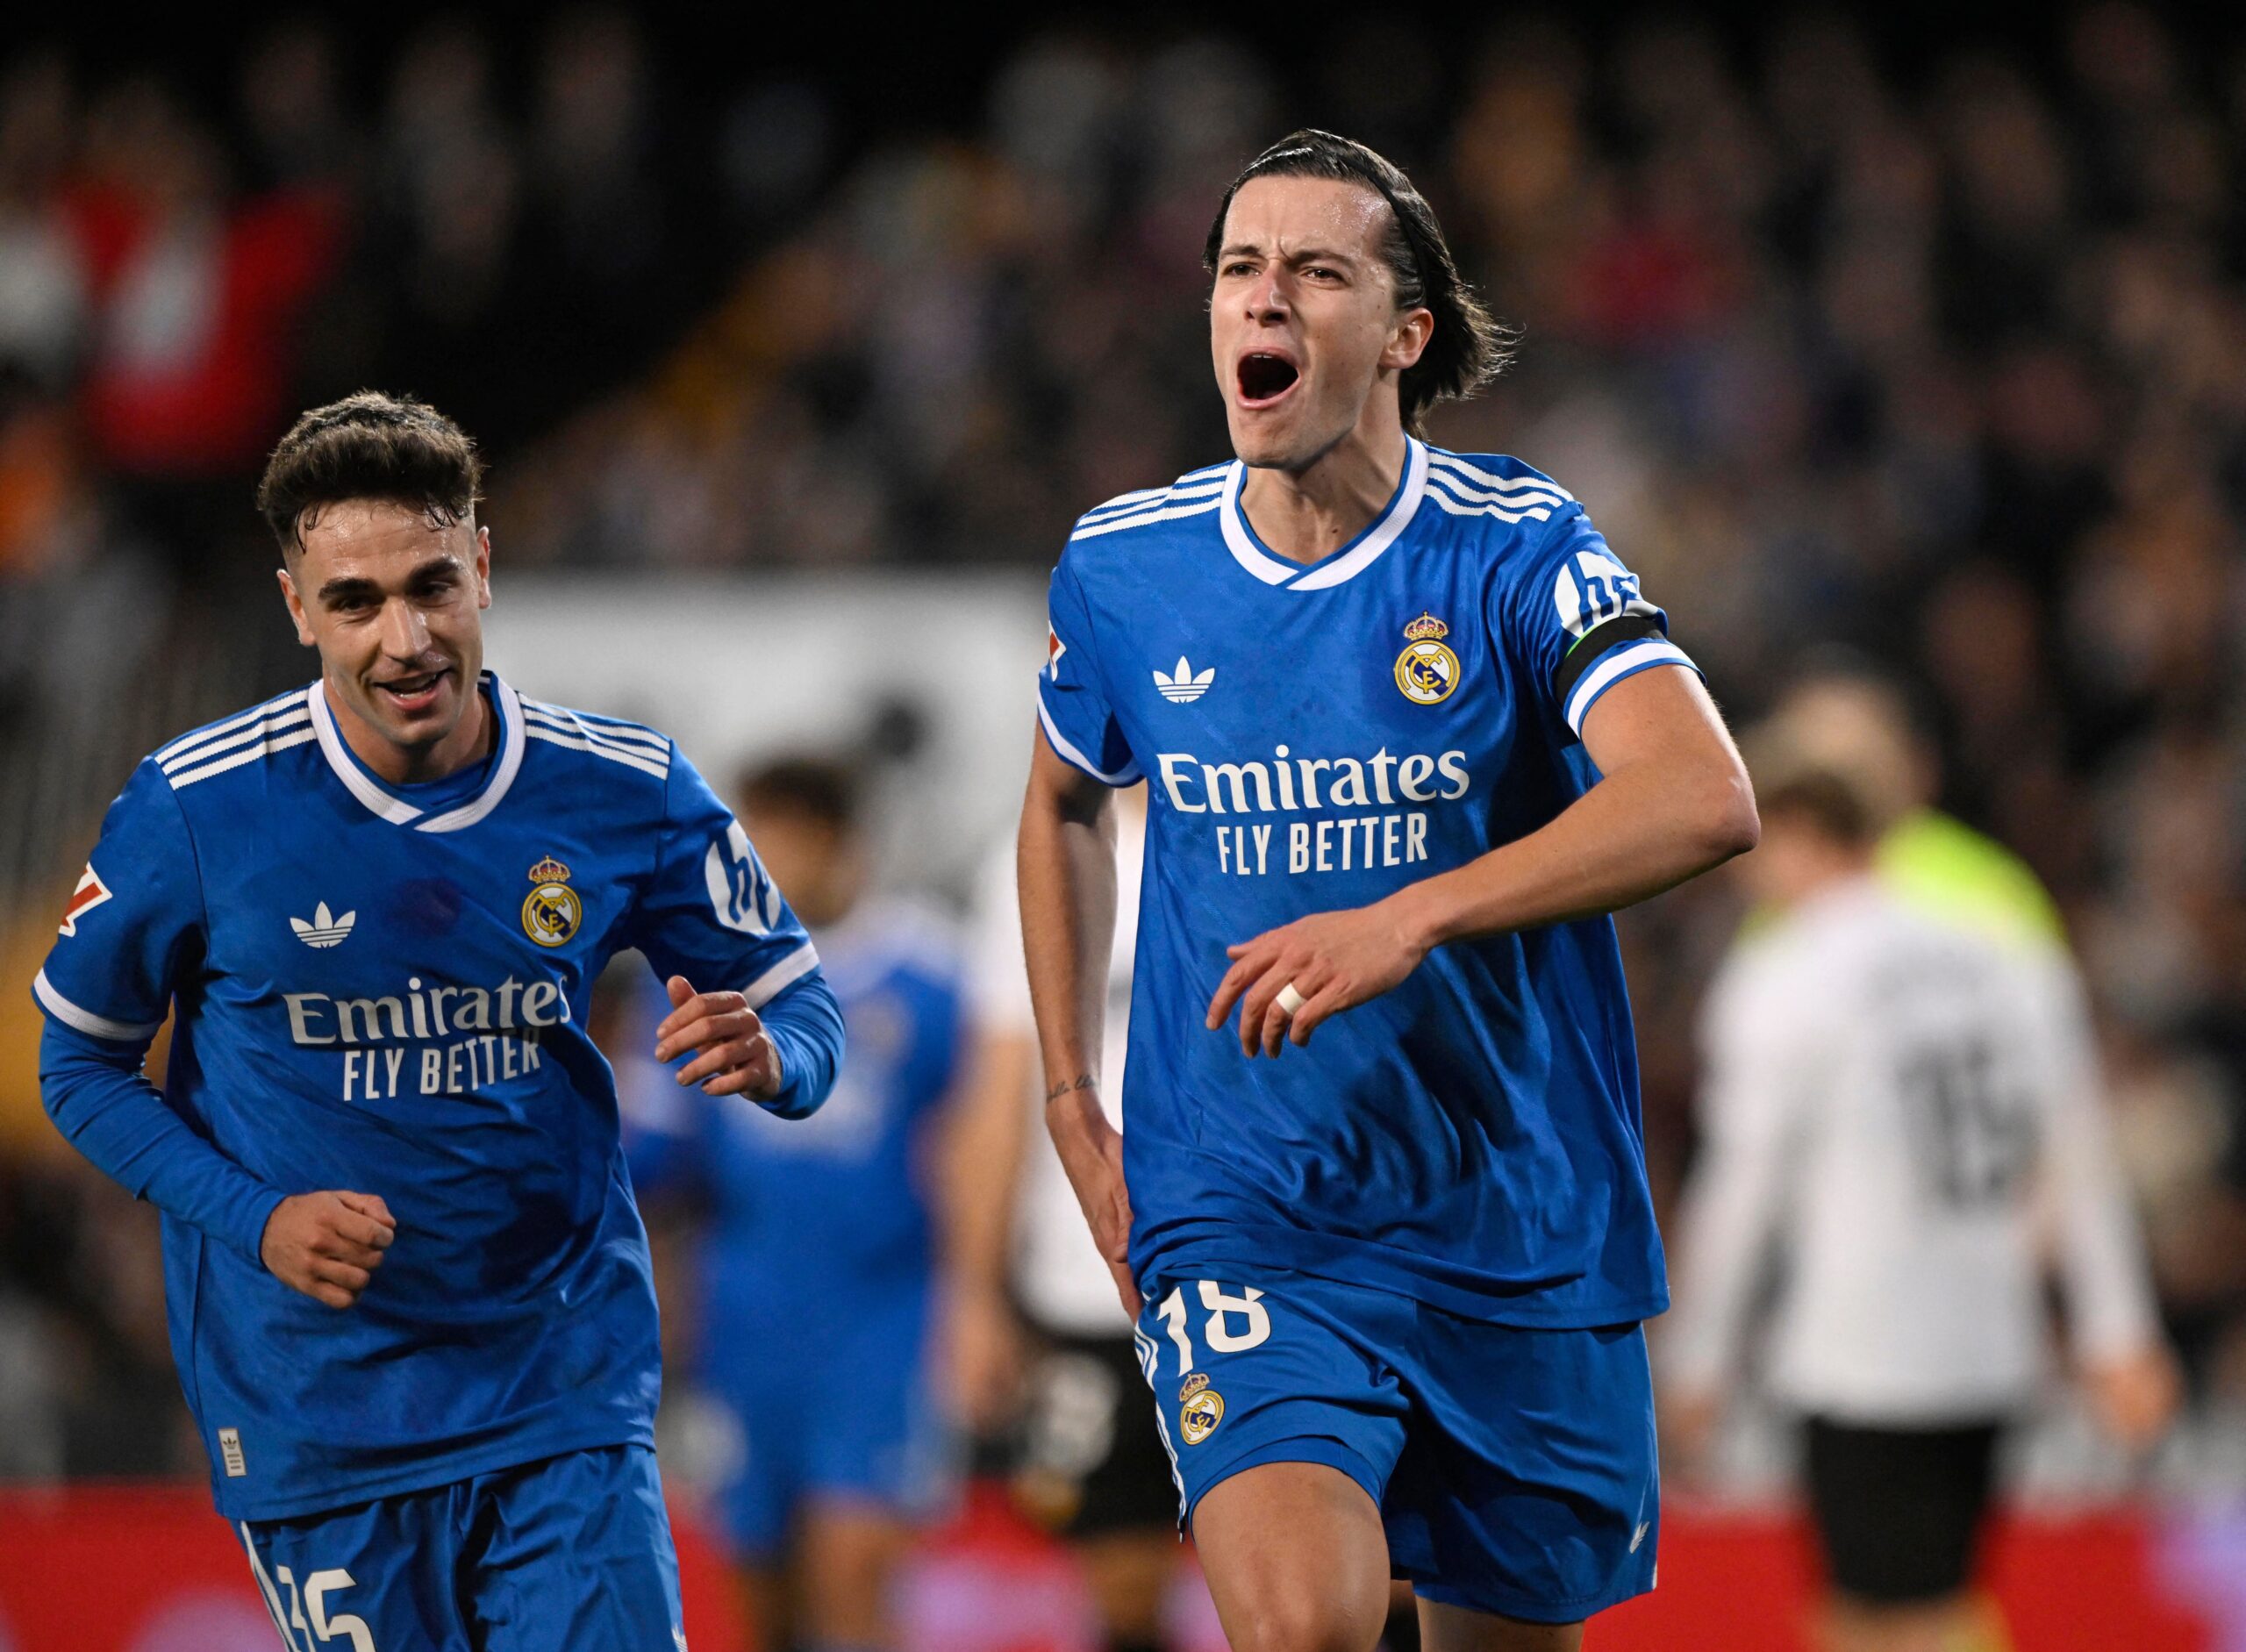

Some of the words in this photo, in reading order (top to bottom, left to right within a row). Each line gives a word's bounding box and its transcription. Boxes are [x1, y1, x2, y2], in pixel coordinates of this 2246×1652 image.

[1156, 744, 1470, 814] Emirates
[1216, 824, 1271, 876] FLY
[1289, 812, 1428, 874] BETTER
[283, 975, 571, 1044] Emirates
[344, 1048, 404, 1102] FLY
[420, 1028, 540, 1096] BETTER
[1156, 1280, 1271, 1377] 18
